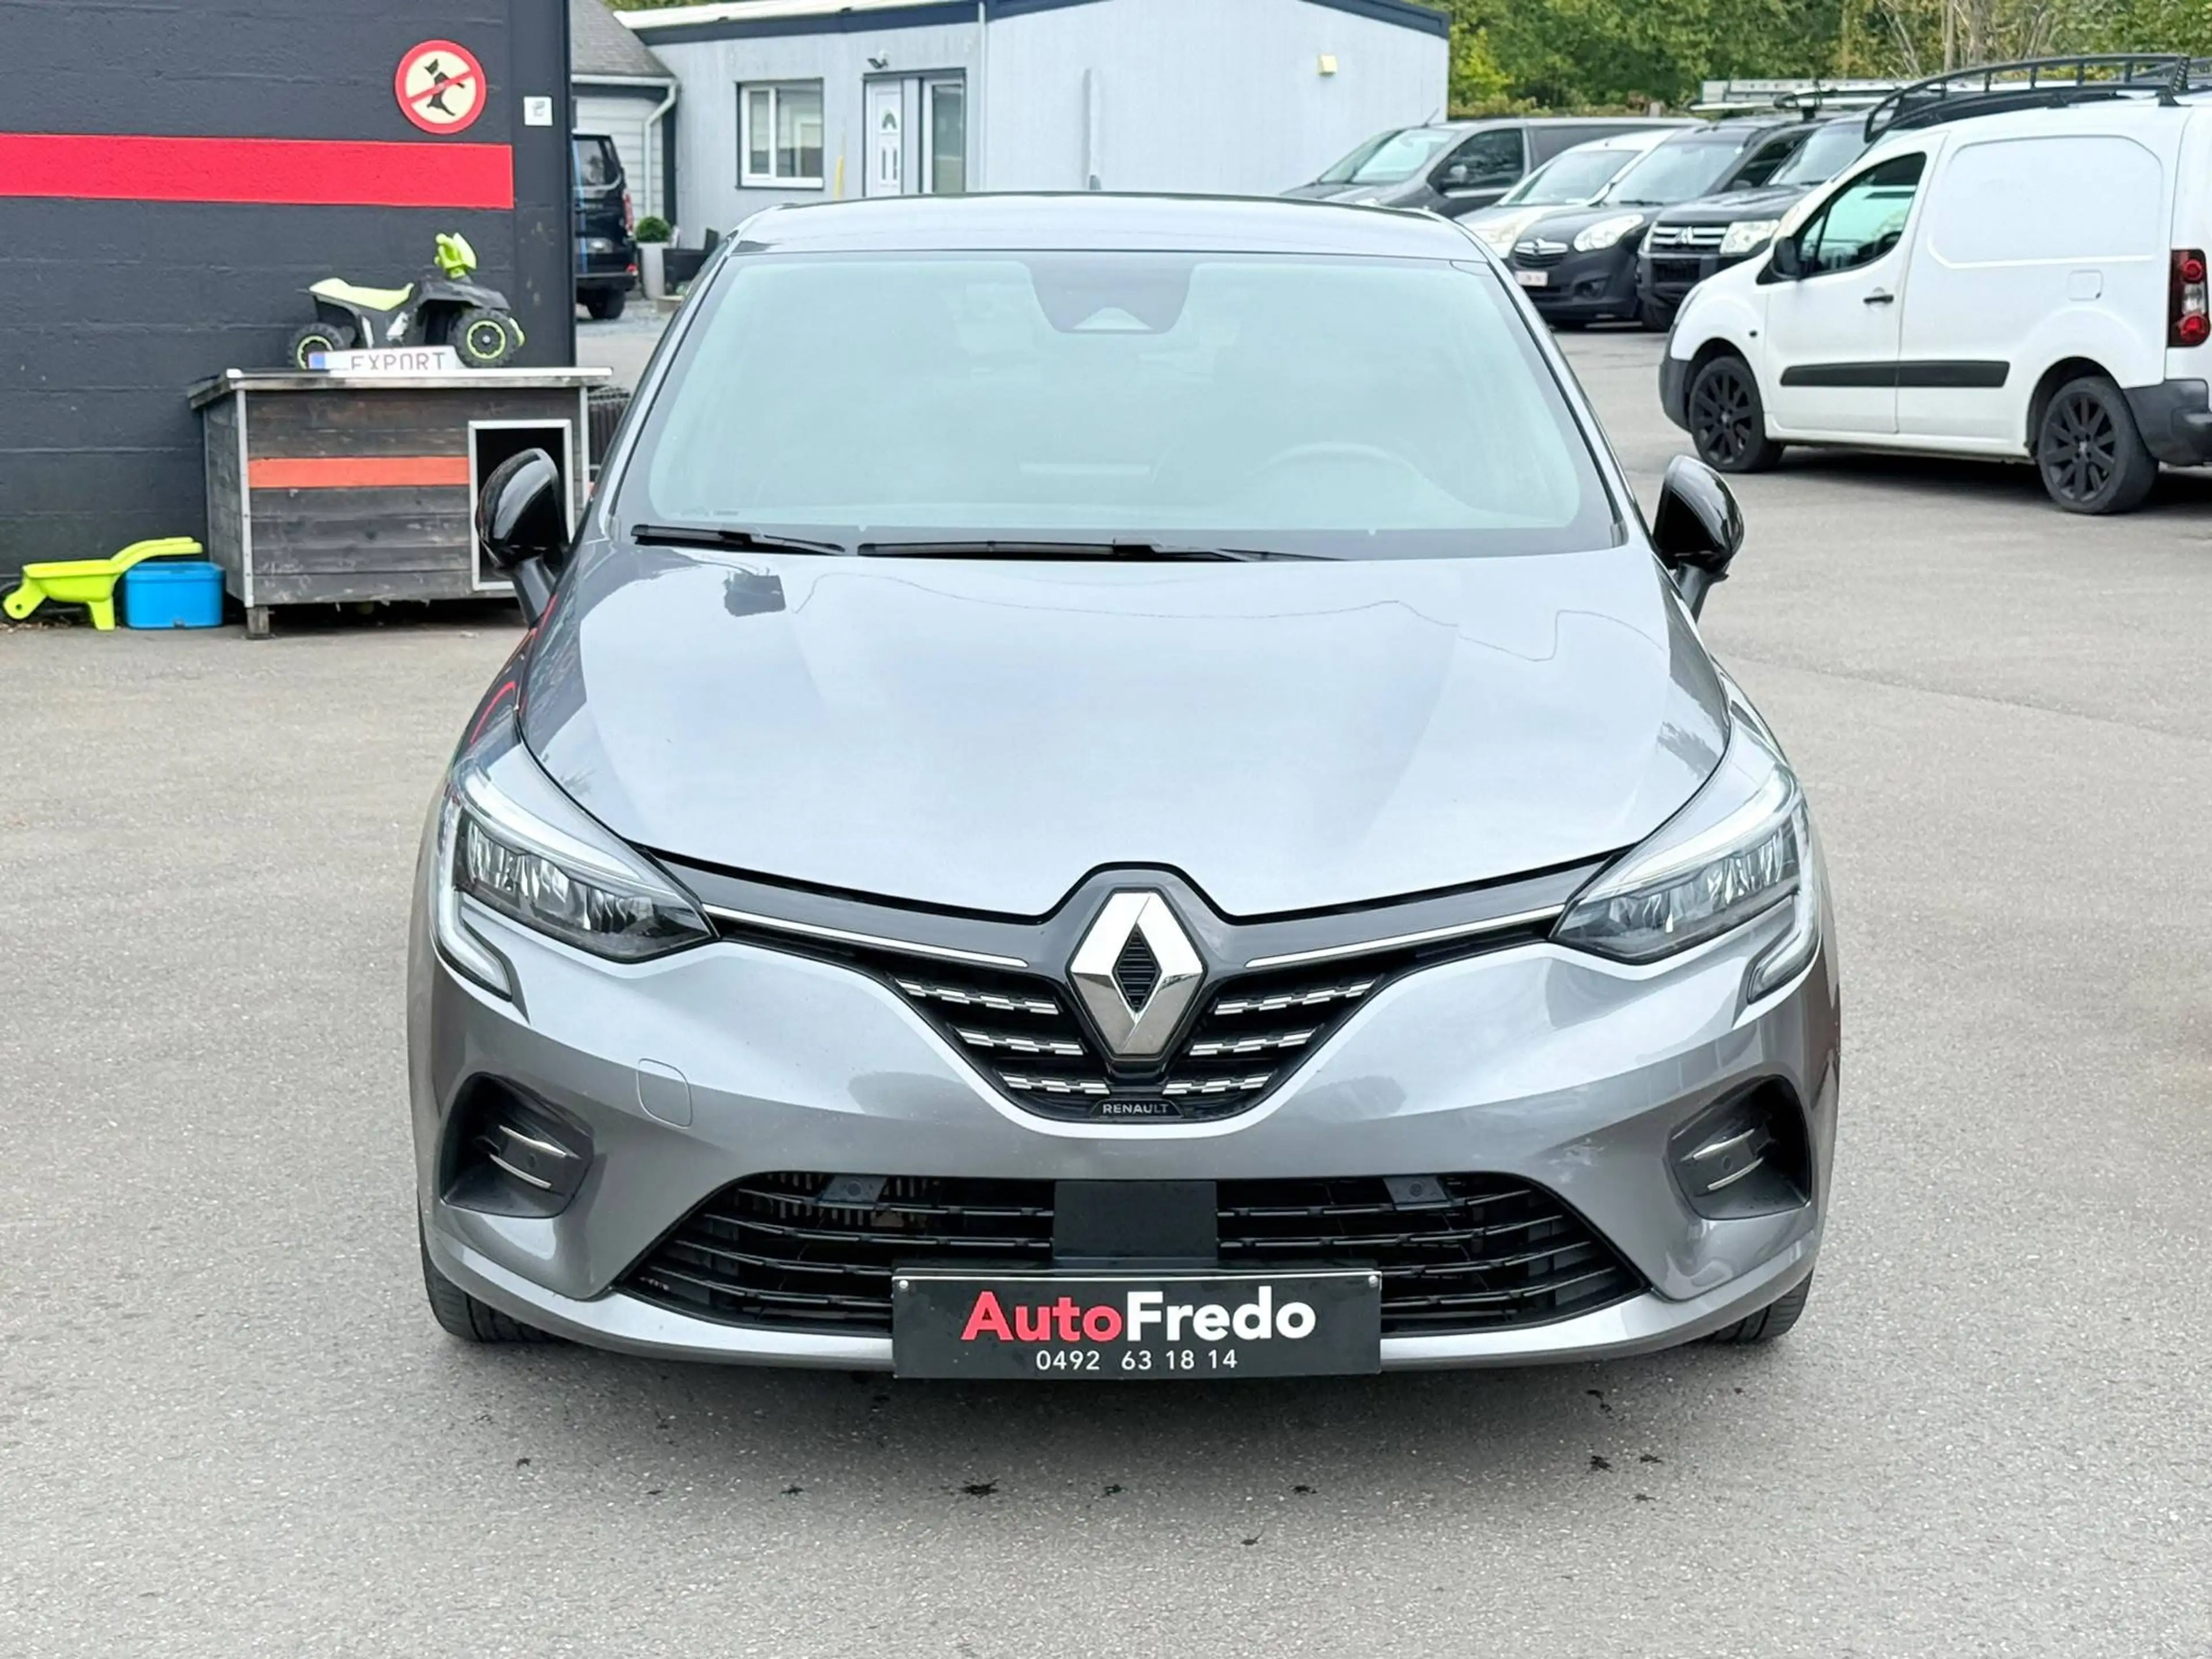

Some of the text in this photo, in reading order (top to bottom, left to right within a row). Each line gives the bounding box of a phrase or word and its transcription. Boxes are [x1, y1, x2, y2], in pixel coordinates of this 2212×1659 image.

[351, 352, 445, 370] EXPORT
[1103, 1104, 1169, 1114] RENAULT
[960, 1285, 1316, 1342] AutoFredo
[1036, 1349, 1238, 1370] 0492 63 18 14
